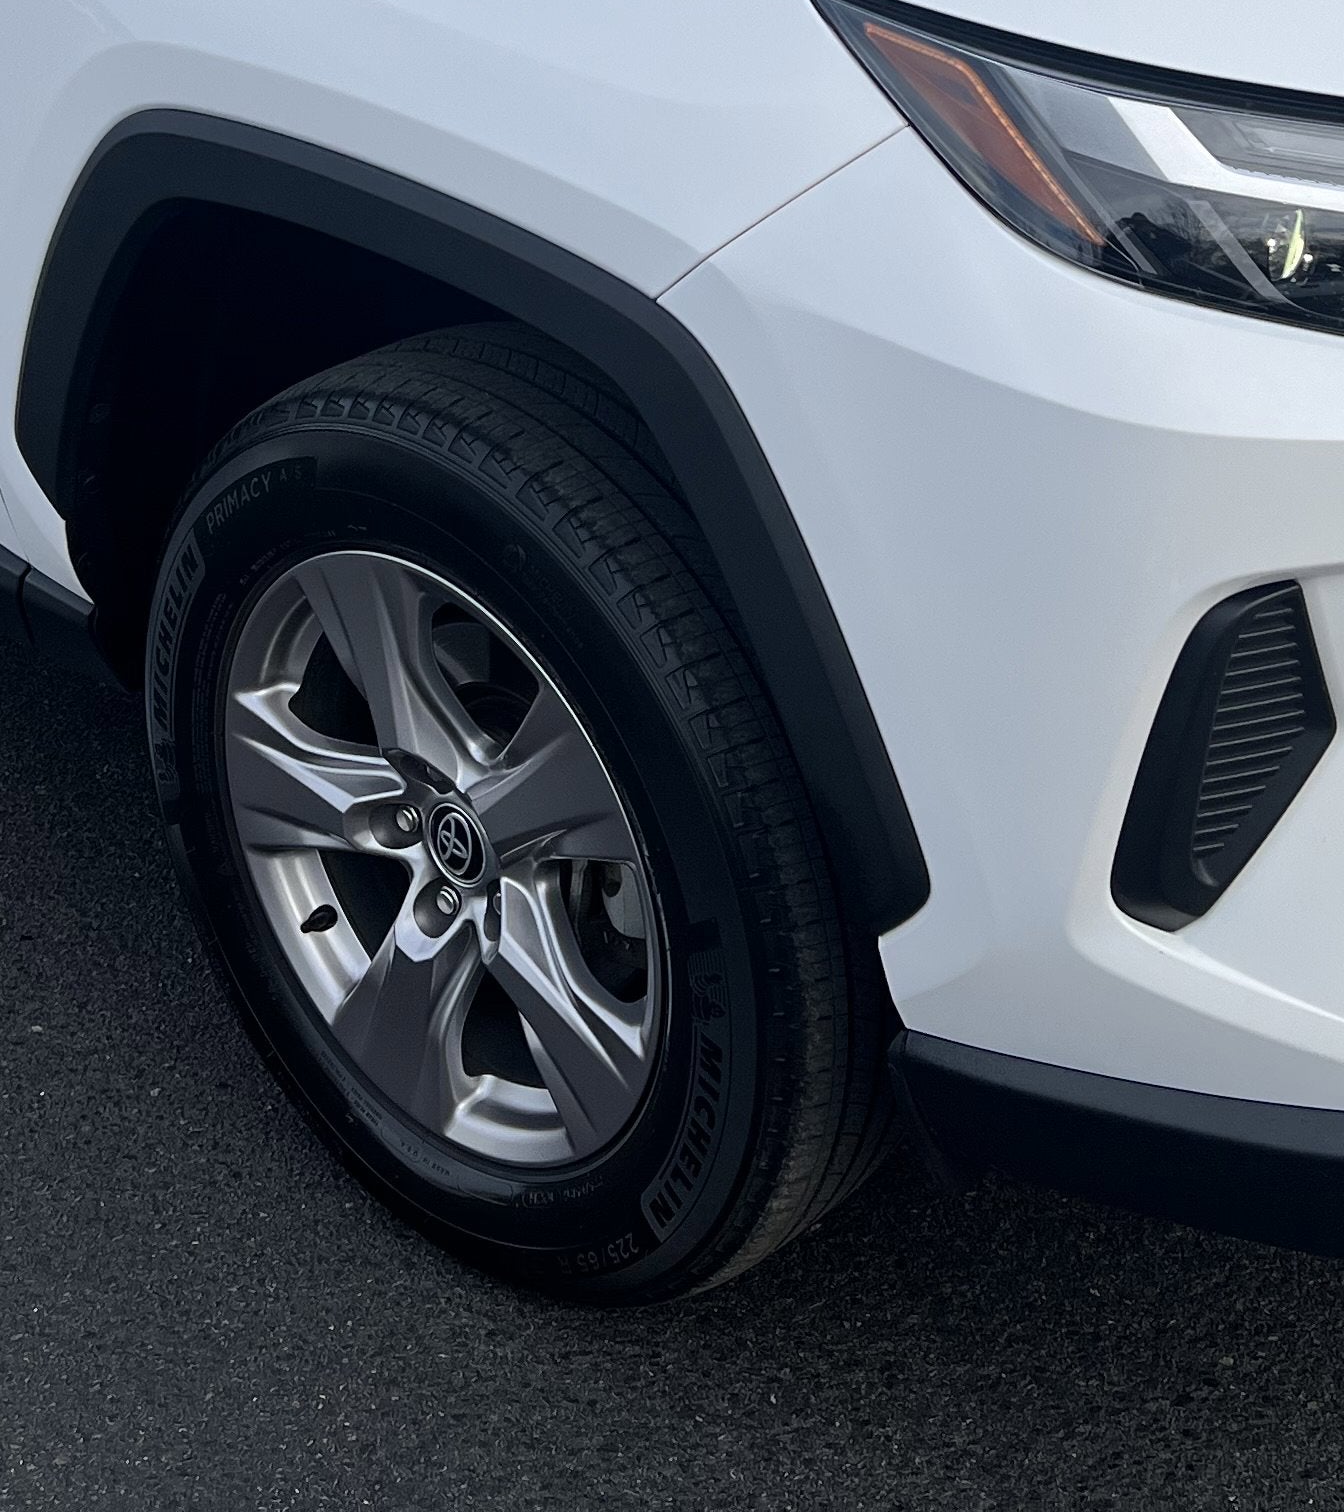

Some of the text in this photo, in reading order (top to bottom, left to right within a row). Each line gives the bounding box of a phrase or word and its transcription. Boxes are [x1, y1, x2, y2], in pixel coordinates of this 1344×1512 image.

[206, 470, 272, 535] PRIMACY
[154, 542, 199, 734] MICHELIN
[648, 1030, 723, 1229] MICHELIN
